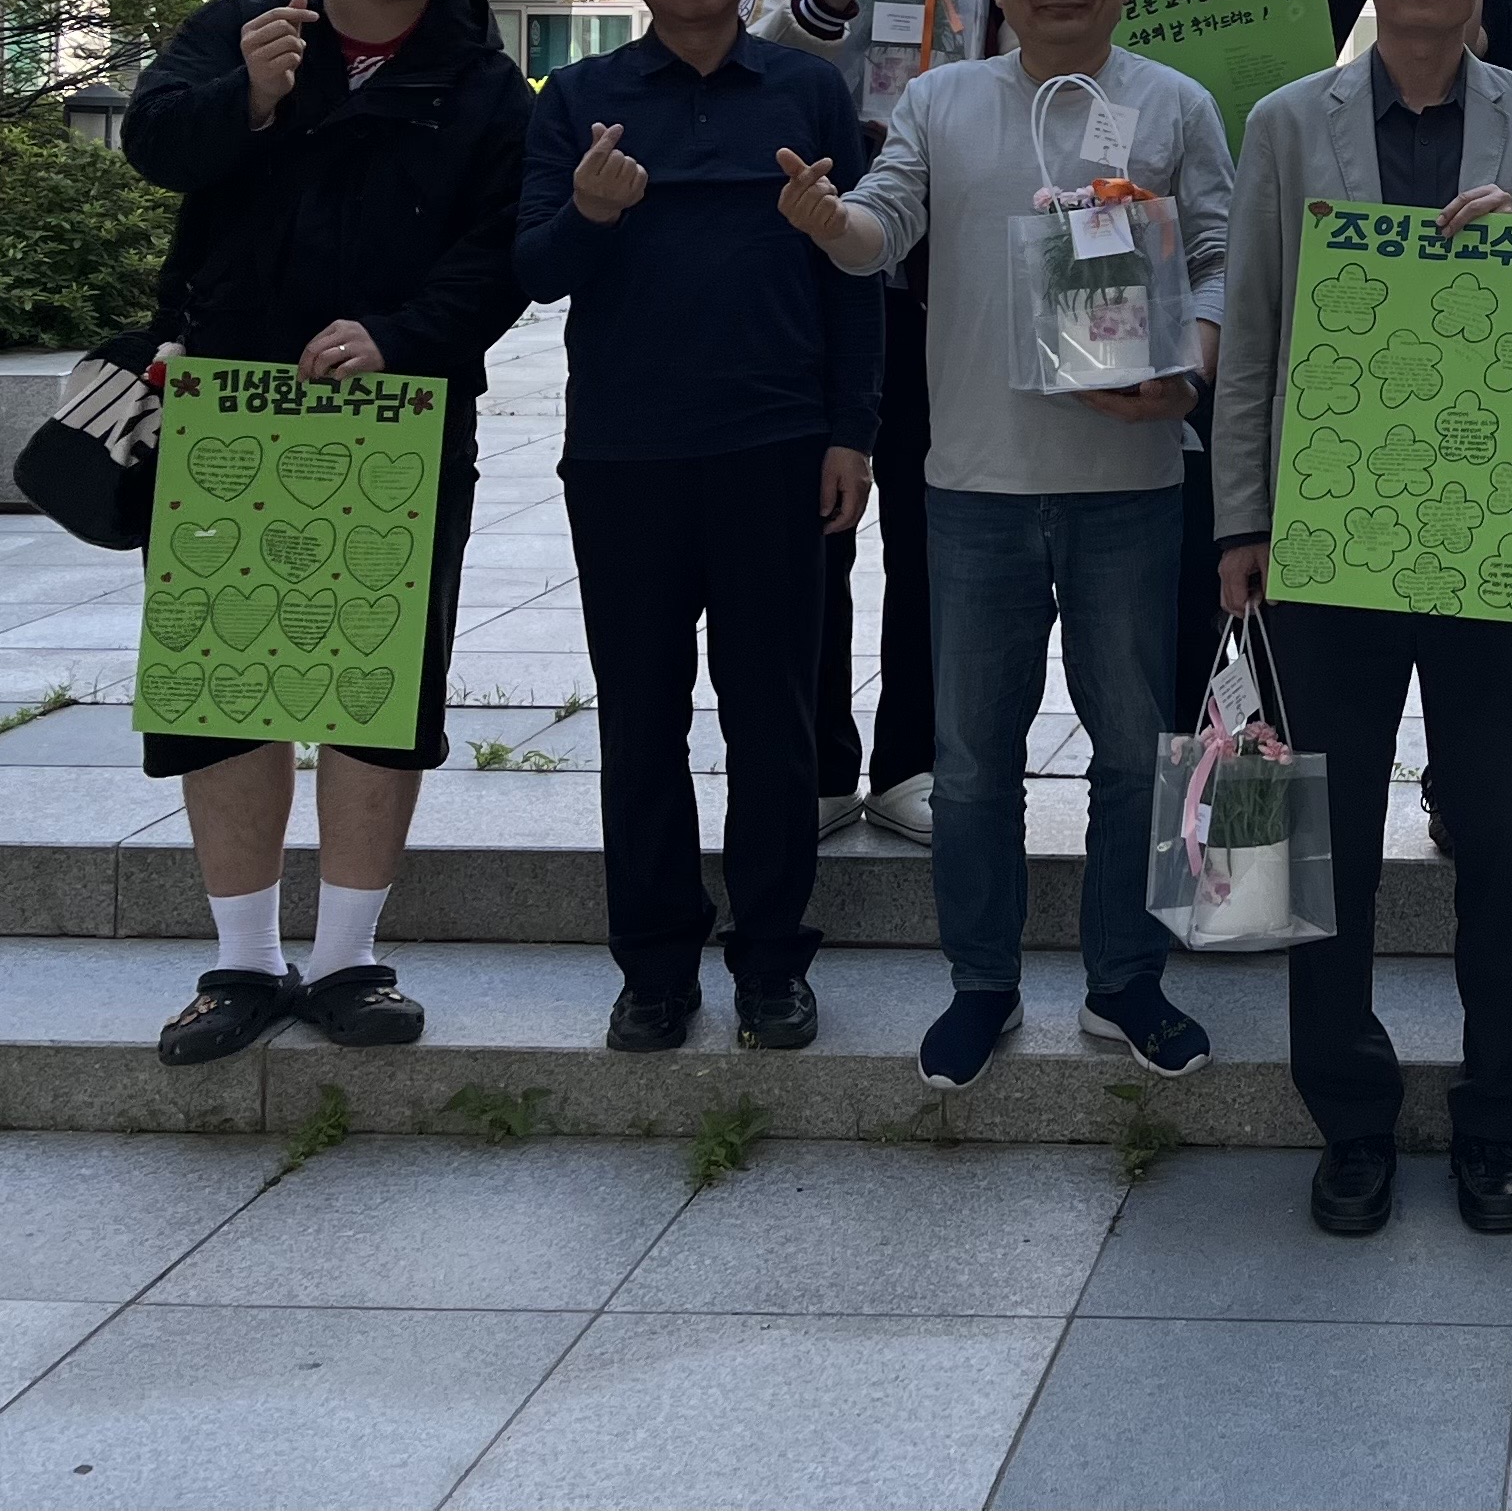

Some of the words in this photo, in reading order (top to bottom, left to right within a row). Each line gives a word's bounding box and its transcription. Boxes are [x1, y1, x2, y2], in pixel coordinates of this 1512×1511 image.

[1127, 23, 1167, 47] 스승의
[1169, 19, 1185, 43] 날
[1190, 10, 1255, 36] 축하드려요
[212, 368, 411, 424] 김성환교수님
